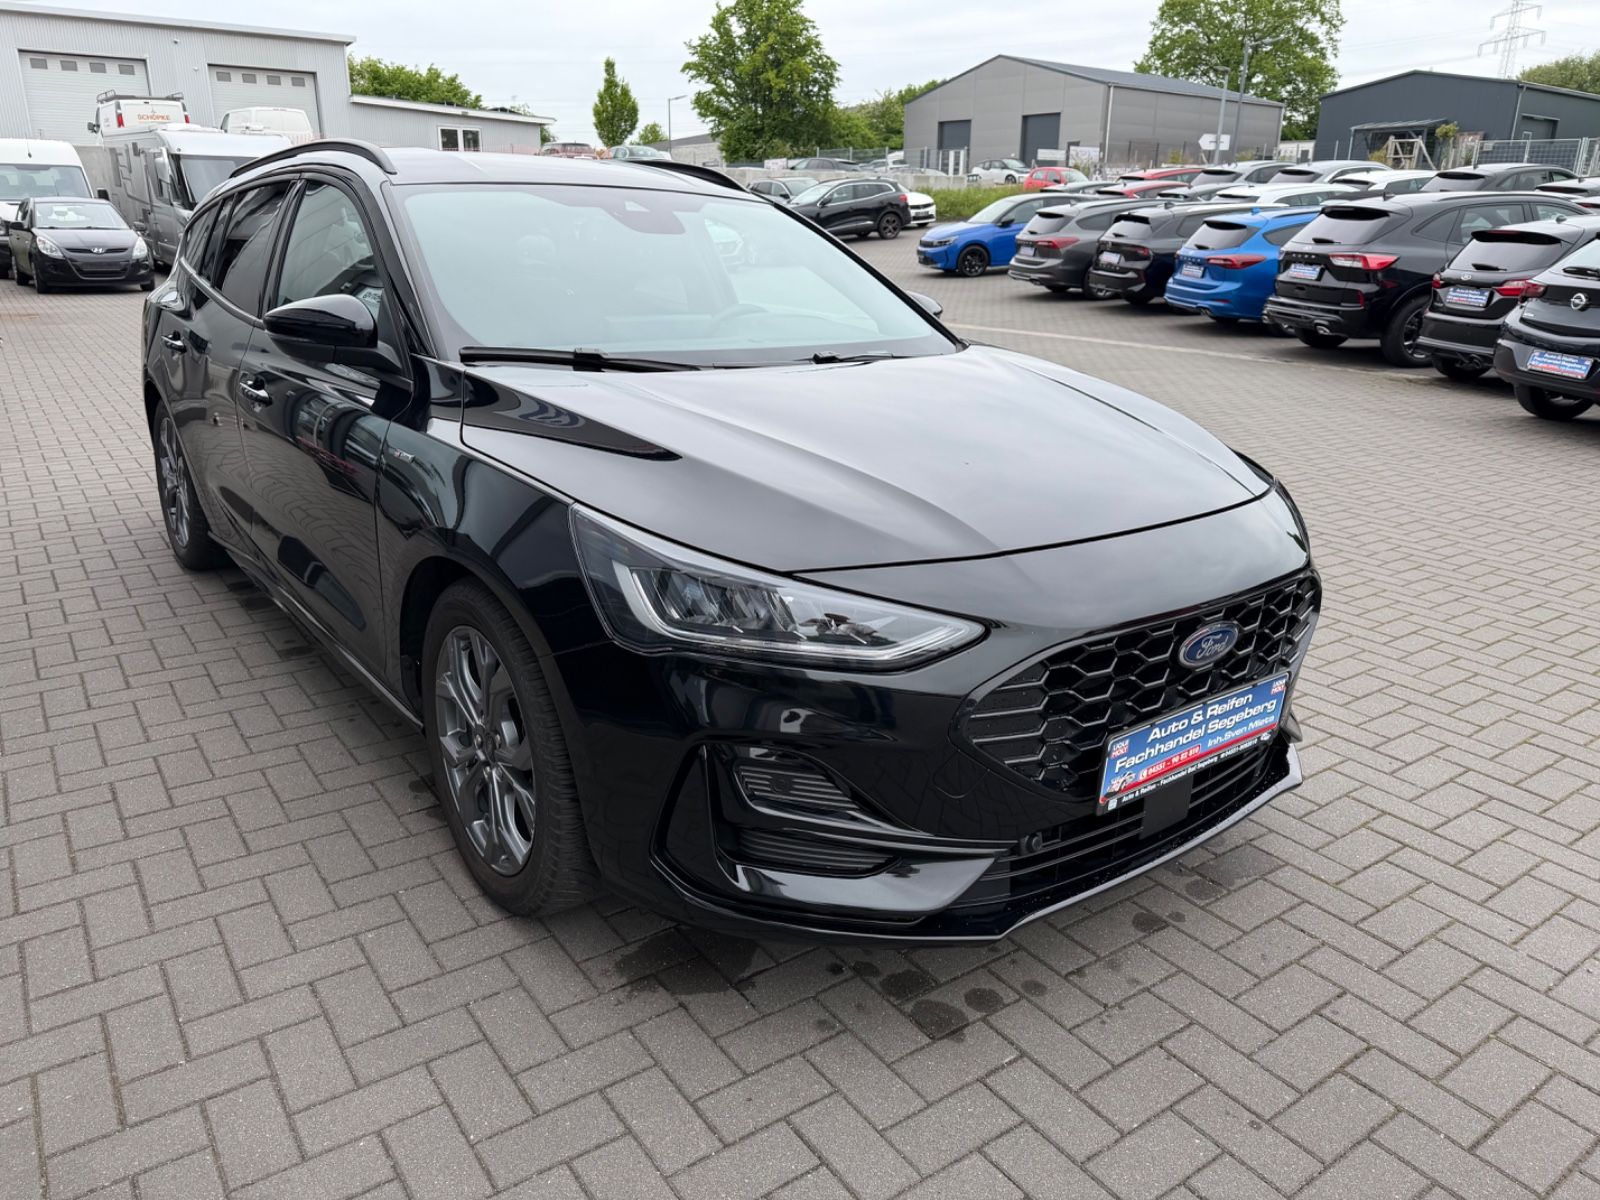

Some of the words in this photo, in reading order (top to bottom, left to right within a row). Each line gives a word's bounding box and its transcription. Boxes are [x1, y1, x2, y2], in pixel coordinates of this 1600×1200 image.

[1196, 633, 1229, 659] Ford
[1115, 726, 1205, 773] Fachhandel
[1207, 699, 1277, 735] Segeberg
[1147, 718, 1187, 744] Auto
[1190, 710, 1204, 725] &
[1206, 693, 1253, 720] Reifen
